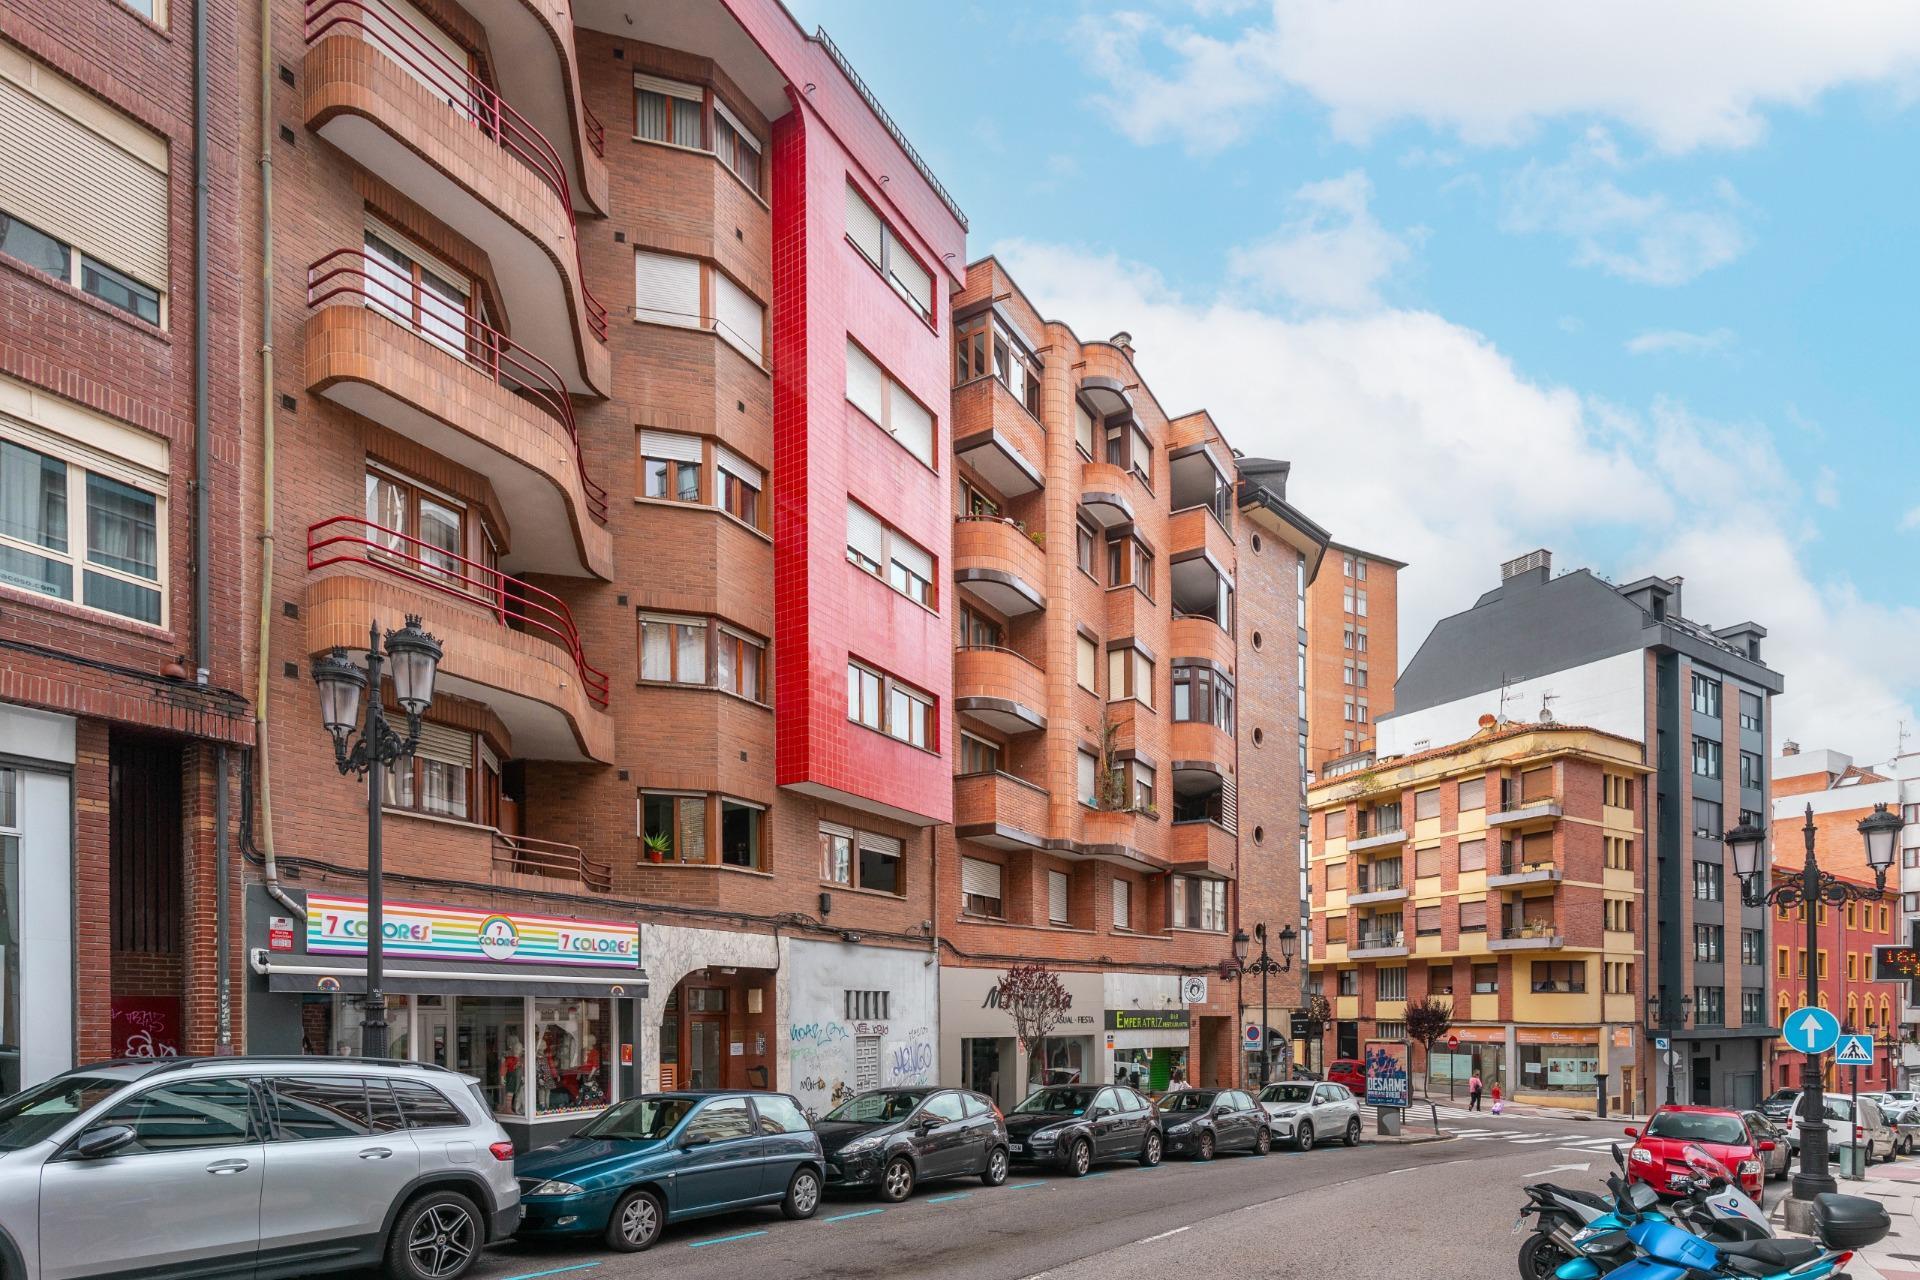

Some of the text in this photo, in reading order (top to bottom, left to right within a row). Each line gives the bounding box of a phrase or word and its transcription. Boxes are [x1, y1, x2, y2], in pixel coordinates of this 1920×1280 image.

[326, 915, 430, 941] 7 COORES
[496, 925, 503, 936] 7
[478, 936, 520, 947] COLORES
[561, 933, 631, 953] 7 COLORES
[1077, 1015, 1095, 1024] FIESTA
[1116, 1011, 1163, 1028] EMPERATRIZ
[1367, 1077, 1408, 1092] DESARME
